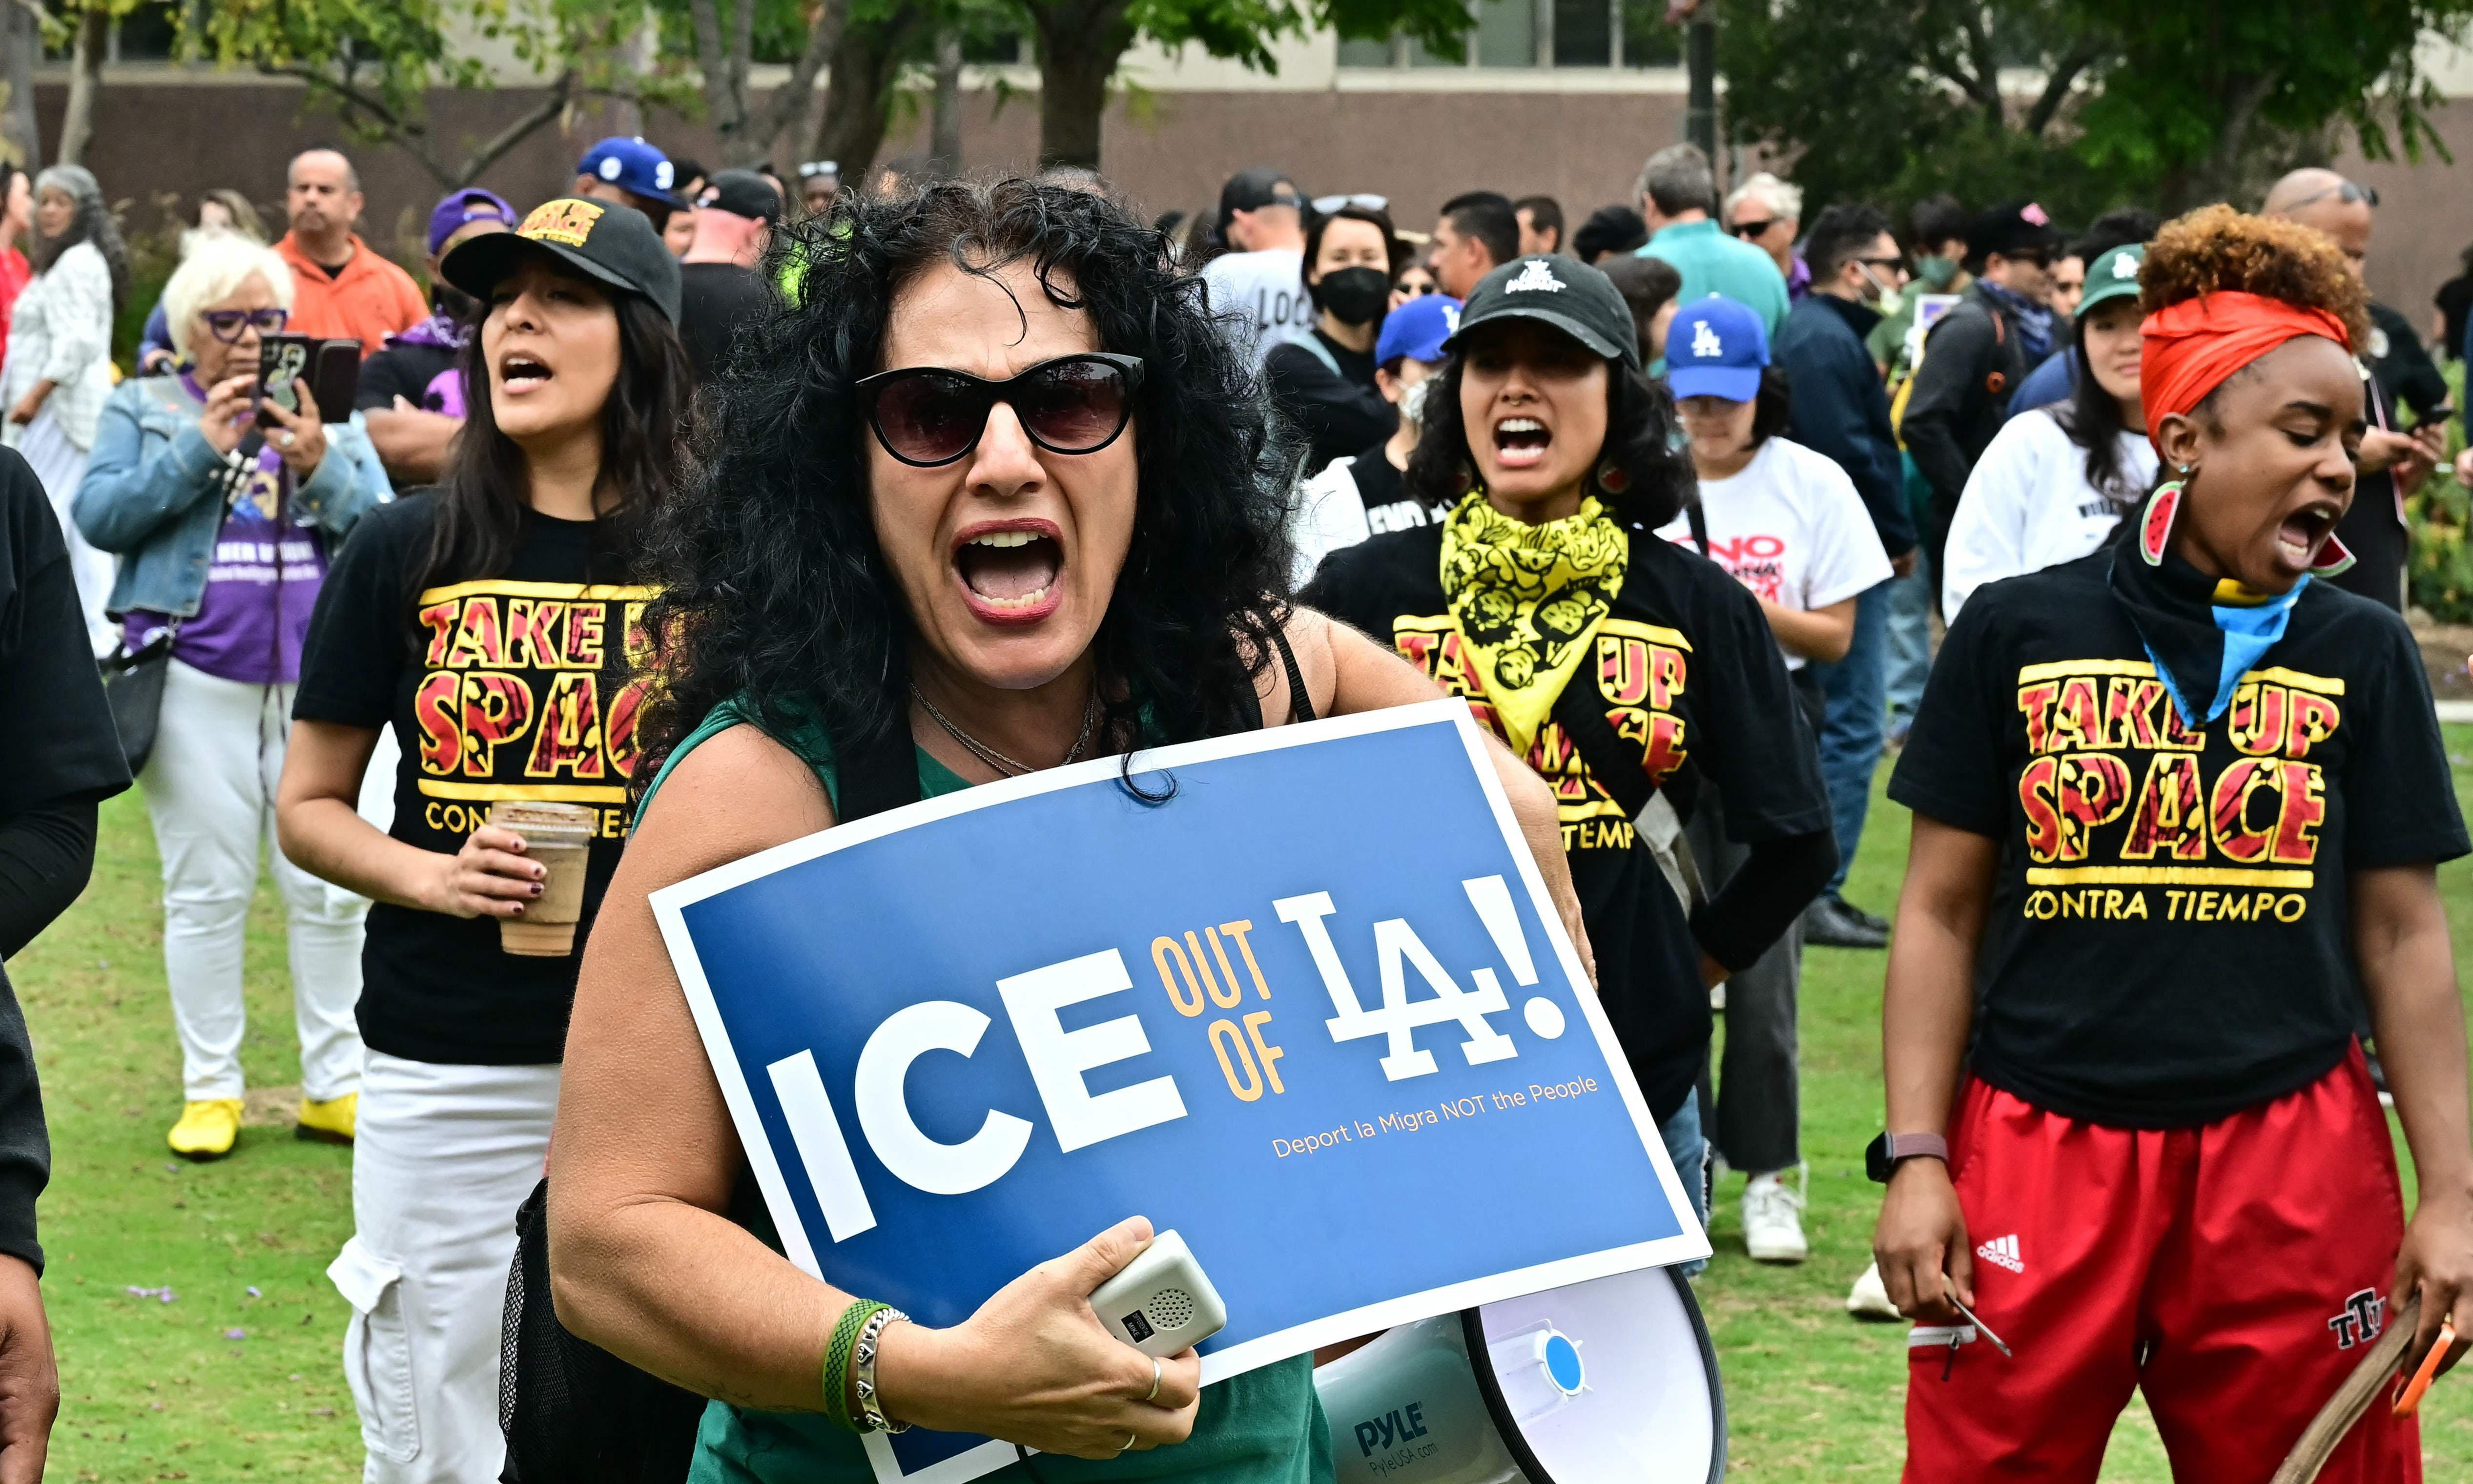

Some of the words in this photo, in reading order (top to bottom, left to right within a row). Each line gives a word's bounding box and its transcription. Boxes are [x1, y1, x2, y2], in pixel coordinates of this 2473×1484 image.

[1691, 320, 1722, 357] LA
[418, 597, 606, 669] TAKE
[1596, 636, 1687, 711] UP
[415, 670, 671, 779] SPAC
[2228, 683, 2340, 758] UP
[2019, 752, 2326, 865] SPACE
[2023, 889, 2148, 920] CONTRA
[2165, 891, 2307, 923] TIEMPO
[1151, 919, 1272, 1017] OUT
[1272, 874, 1566, 1082] LA!
[1207, 1010, 1285, 1102] OF
[766, 948, 1188, 1243] ICE
[1272, 1124, 1352, 1158] Deport
[1354, 1120, 1376, 1139] la
[1378, 1112, 1439, 1134] Migra
[1440, 1094, 1485, 1120] NOT
[1492, 1091, 1526, 1110] the
[1528, 1075, 1598, 1103] People
[1977, 1245, 2025, 1274] adidas
[1127, 1322, 1141, 1338] MIKE
[1354, 1402, 1428, 1458] PYLE
[1369, 1443, 1439, 1478] PyleUSA.com
